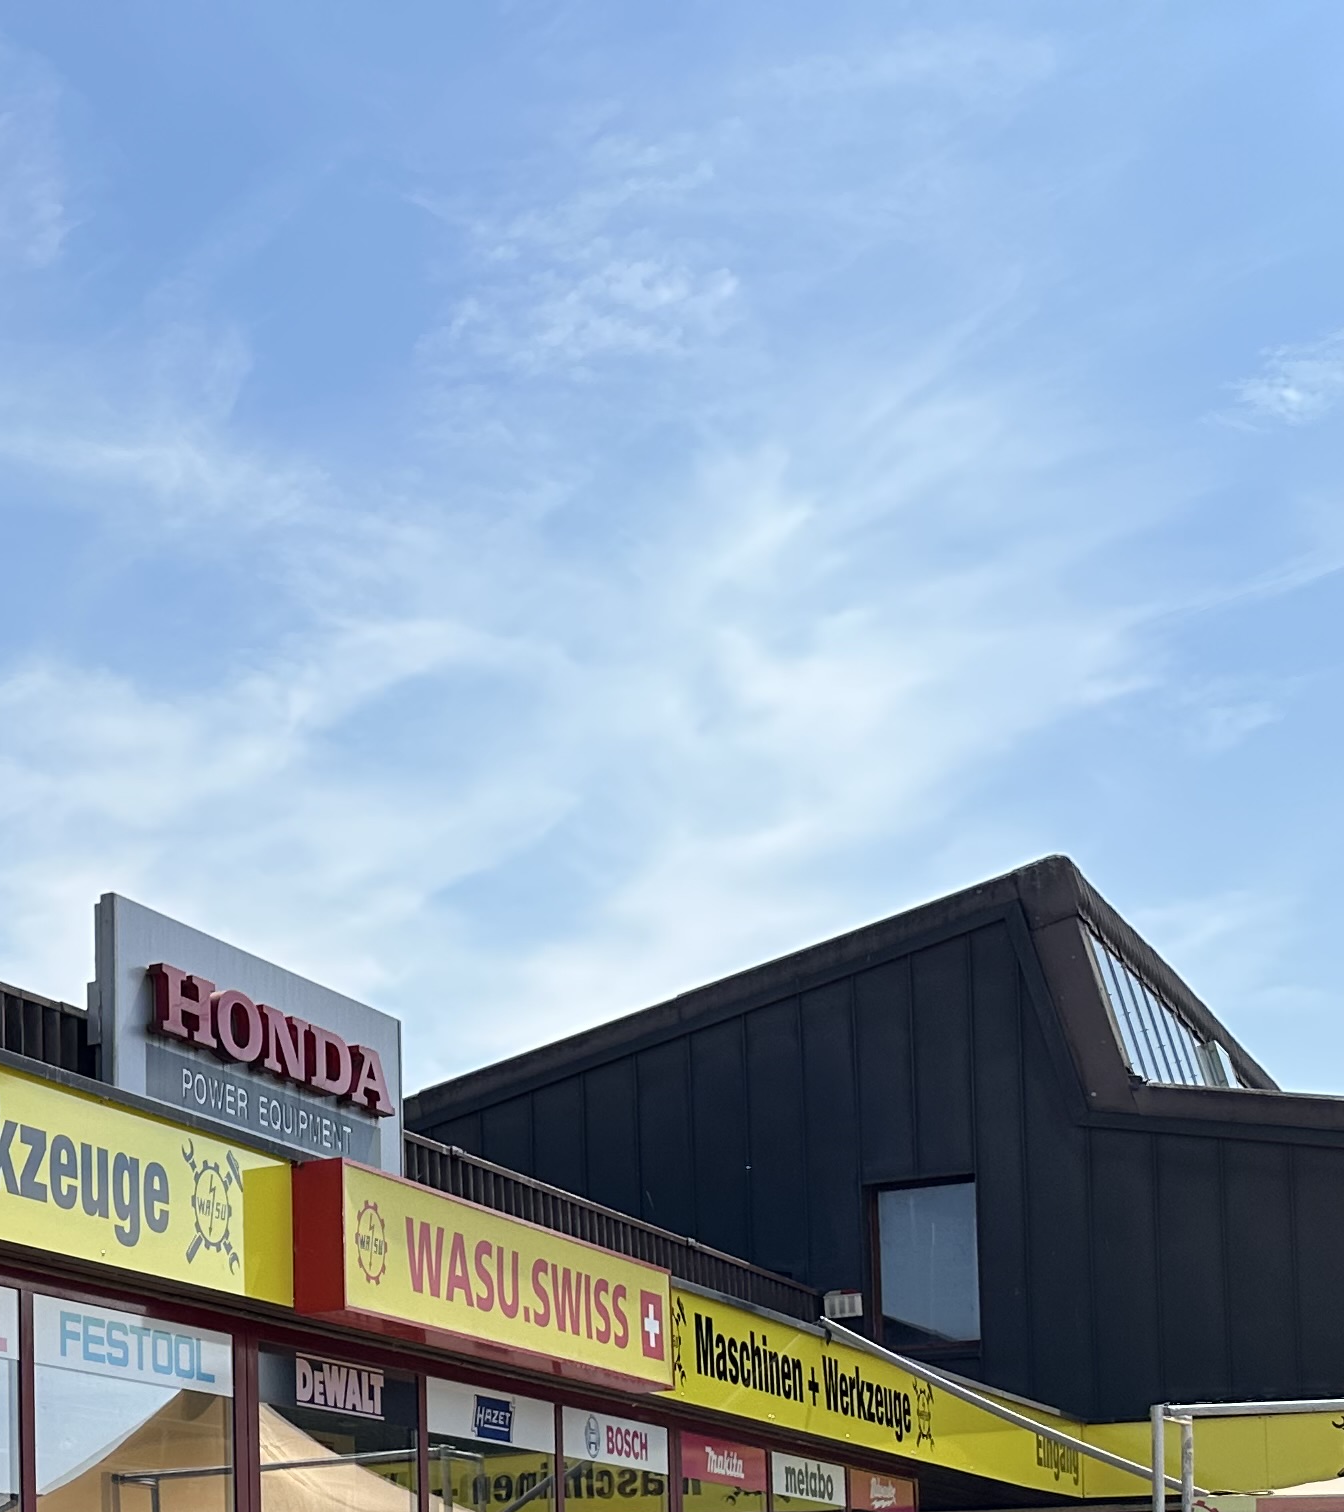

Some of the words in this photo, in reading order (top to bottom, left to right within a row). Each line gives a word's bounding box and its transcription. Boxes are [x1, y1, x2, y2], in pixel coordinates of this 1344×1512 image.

[148, 962, 395, 1118] HONDA
[182, 1067, 249, 1121] POWER
[259, 1095, 353, 1154] EQUIPMENT
[405, 1216, 630, 1349] WASU.SWISS
[60, 1312, 216, 1384] FESTOOL
[694, 1313, 804, 1403] Maschinen
[821, 1355, 912, 1443] Werkzeuge
[476, 1406, 512, 1428] HAZET
[606, 1425, 648, 1461] BOSCH
[785, 1462, 834, 1501] metabo
